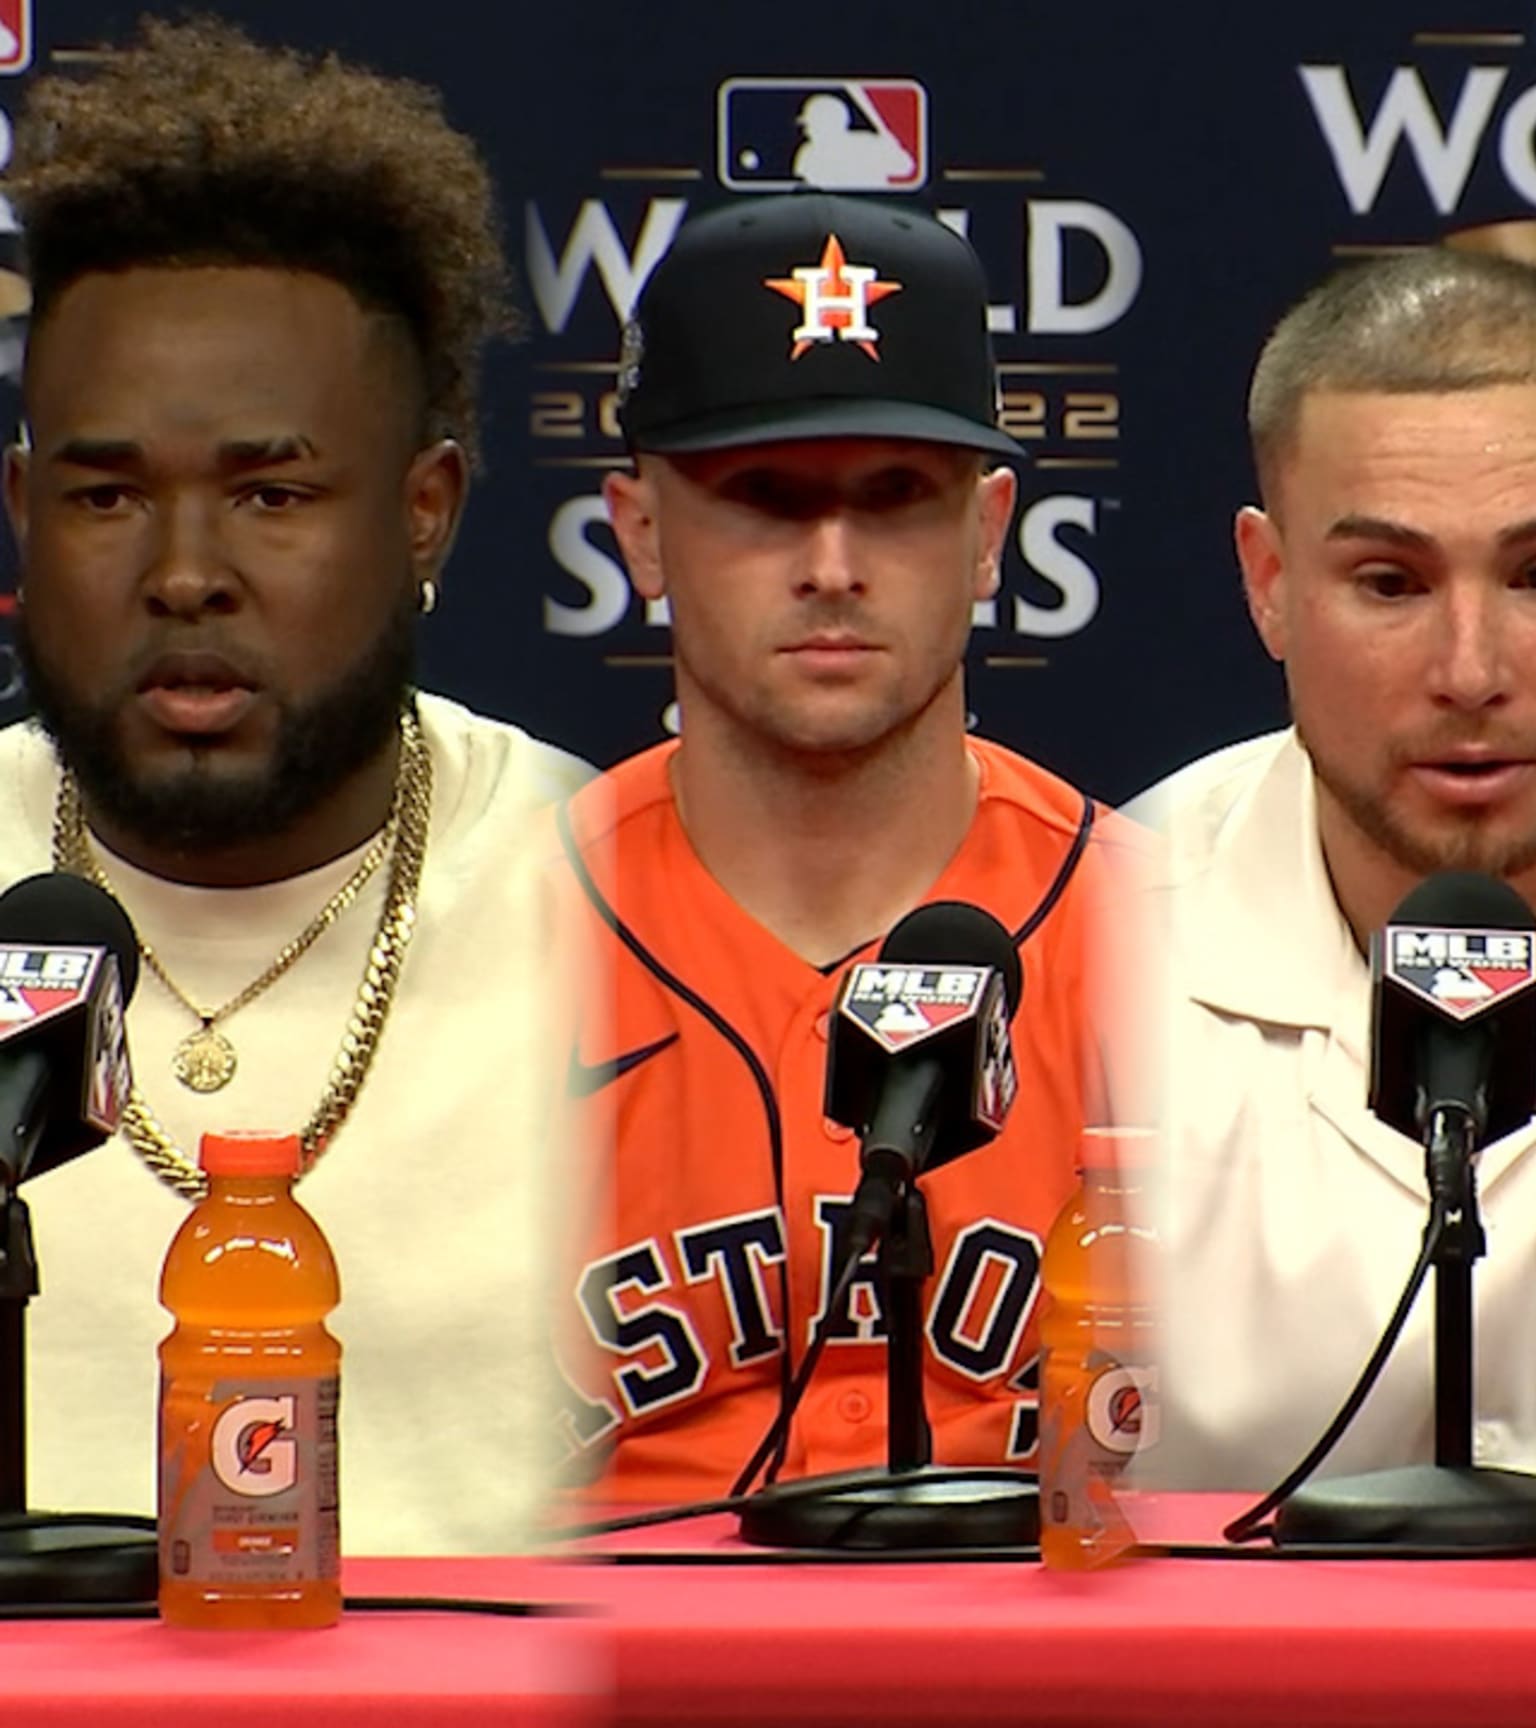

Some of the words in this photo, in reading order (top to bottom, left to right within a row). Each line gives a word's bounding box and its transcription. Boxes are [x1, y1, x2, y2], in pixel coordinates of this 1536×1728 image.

[792, 265, 878, 341] H
[1396, 933, 1529, 960] MLB
[0, 952, 90, 980] LB
[1396, 957, 1529, 970] NETWORK
[854, 969, 978, 994] MLB
[211, 1395, 298, 1498] G
